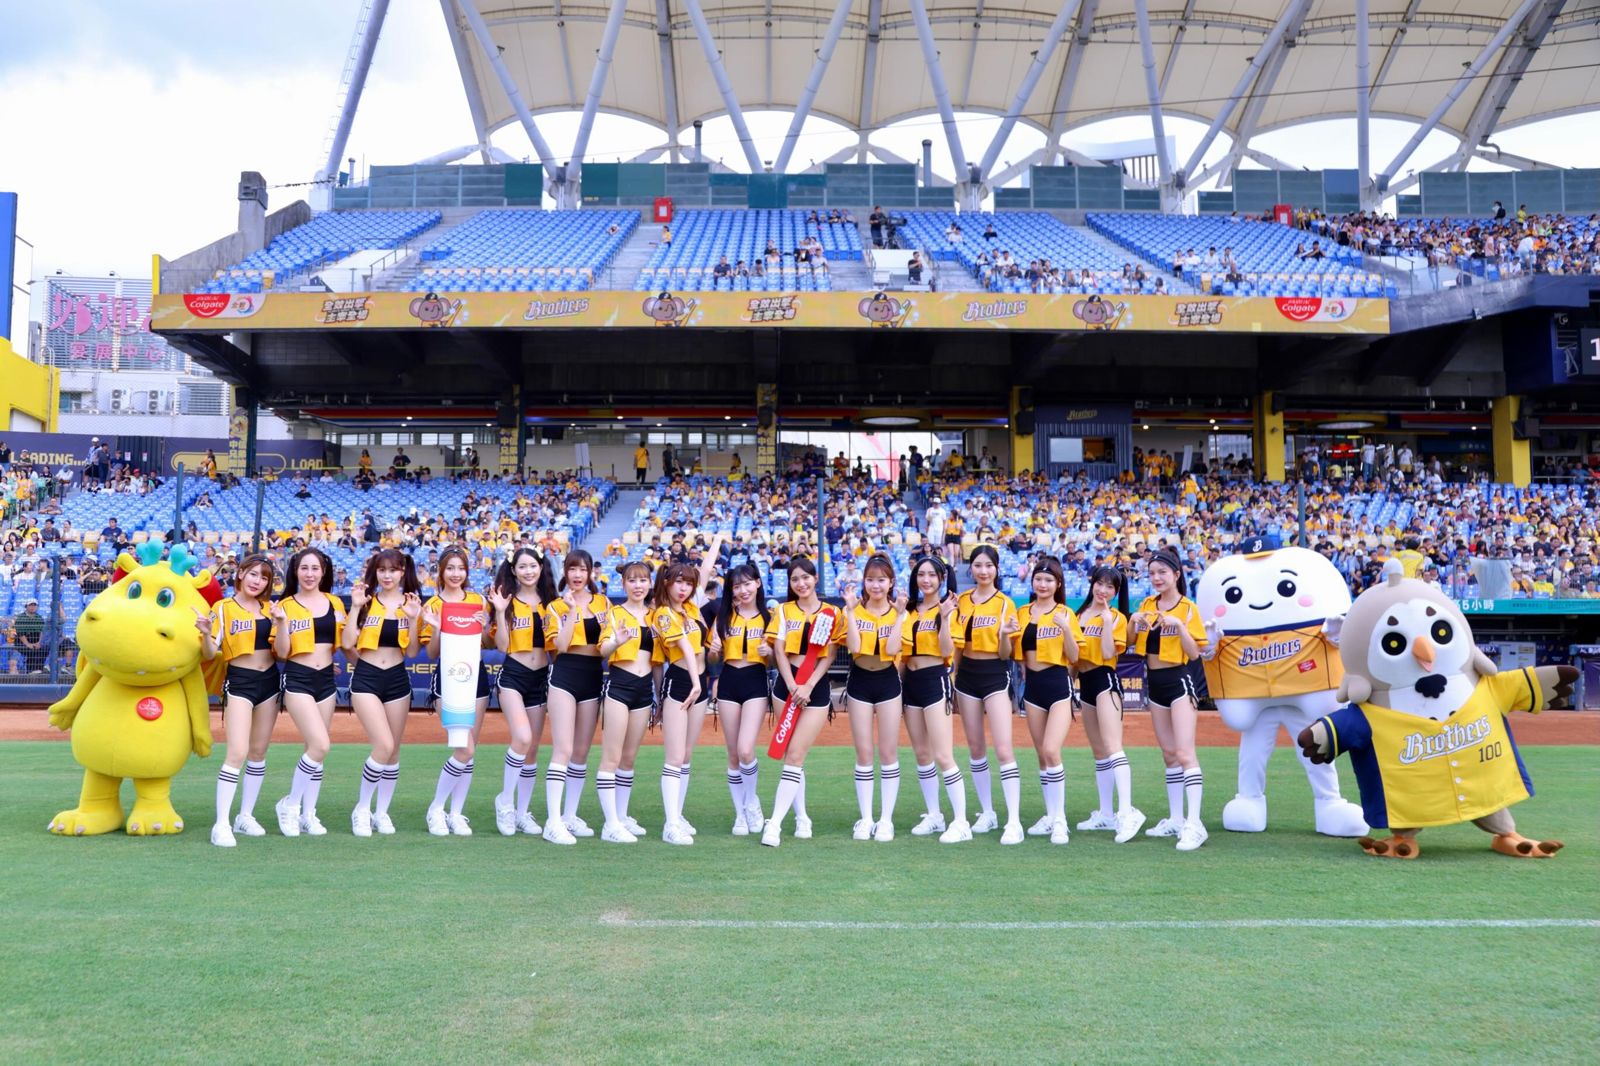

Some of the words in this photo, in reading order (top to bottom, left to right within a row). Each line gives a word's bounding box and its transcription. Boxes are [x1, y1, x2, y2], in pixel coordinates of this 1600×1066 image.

[48, 292, 152, 336] 好運
[189, 300, 225, 309] Colgate
[523, 296, 591, 321] Brothers
[961, 299, 1027, 322] Brothers
[1281, 302, 1316, 312] Colgate
[1238, 639, 1301, 667] Brothers
[775, 699, 797, 745] Colgate
[1398, 714, 1492, 765] Brothers
[1479, 741, 1503, 763] 100
